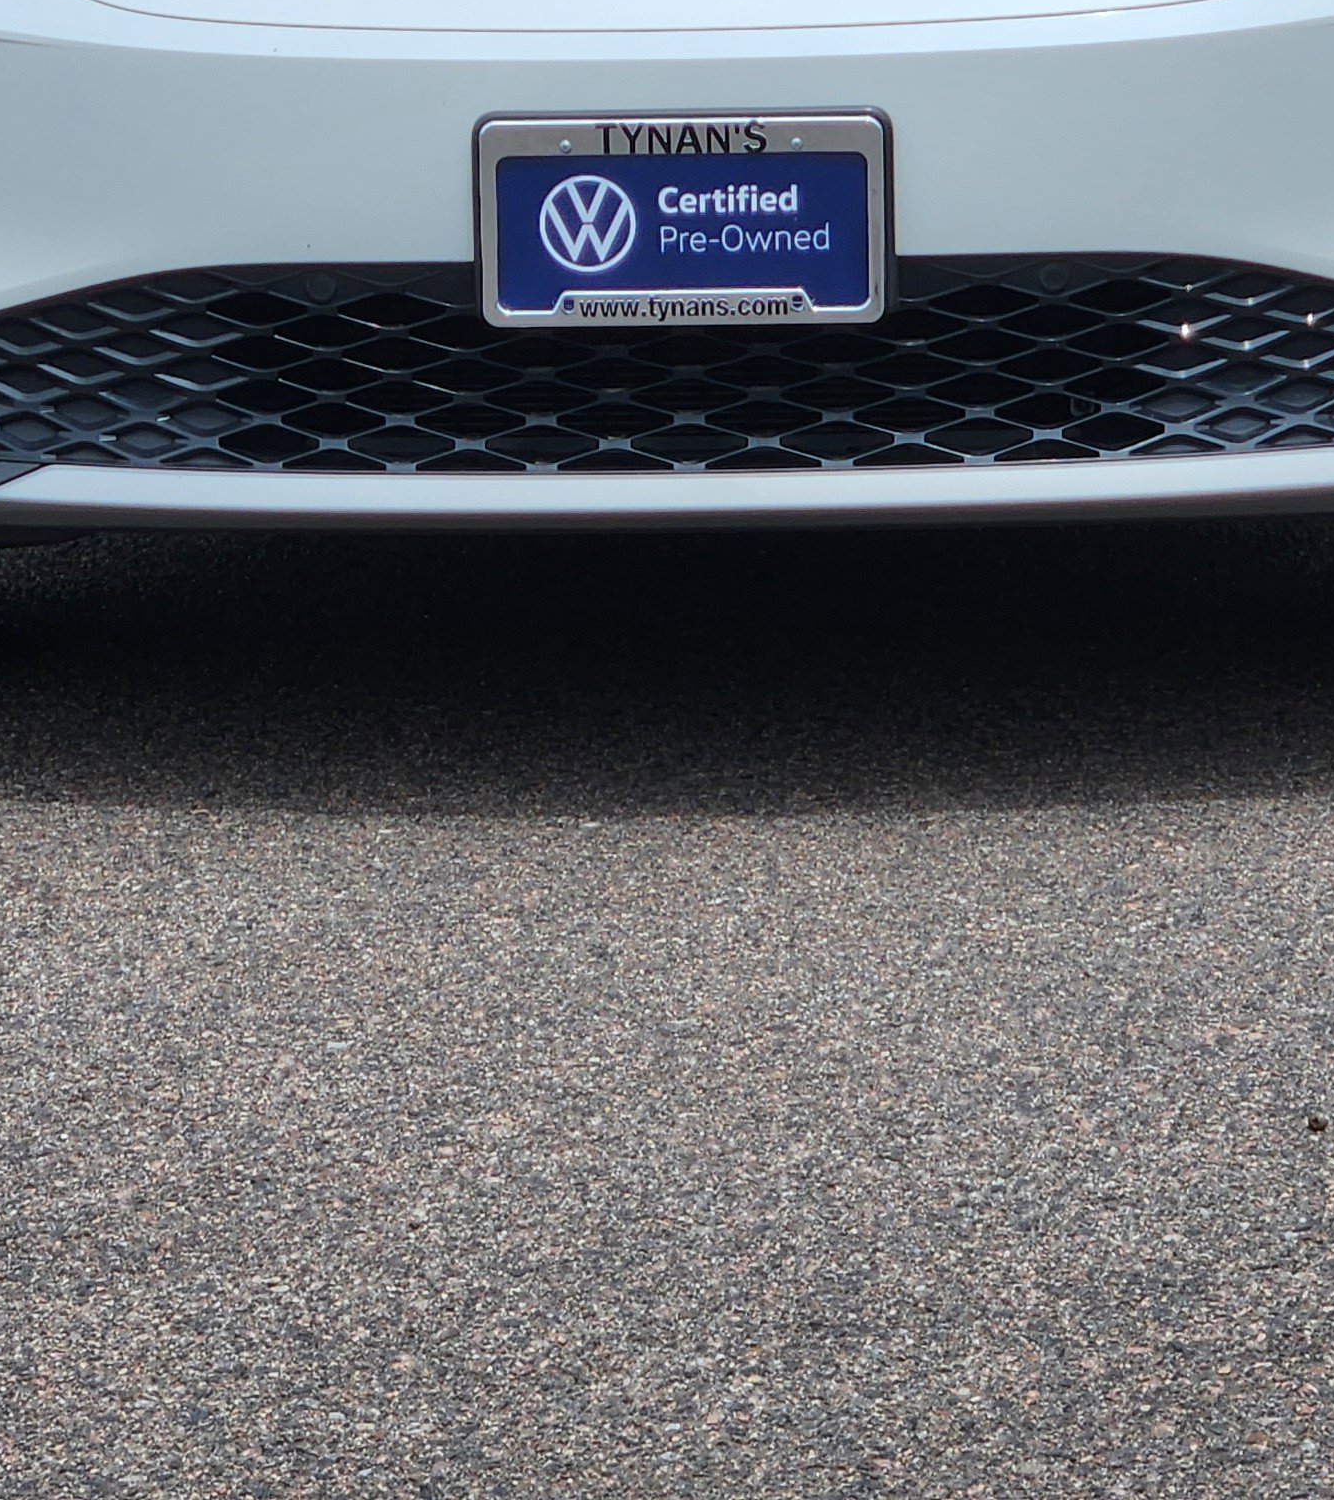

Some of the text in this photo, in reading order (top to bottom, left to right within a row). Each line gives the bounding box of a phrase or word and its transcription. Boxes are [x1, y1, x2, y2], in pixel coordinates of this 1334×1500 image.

[595, 119, 768, 155] TYNAN'S
[657, 184, 799, 214] Certified
[659, 221, 831, 254] Pre-Owned
[579, 294, 789, 322] www.tynans.com
